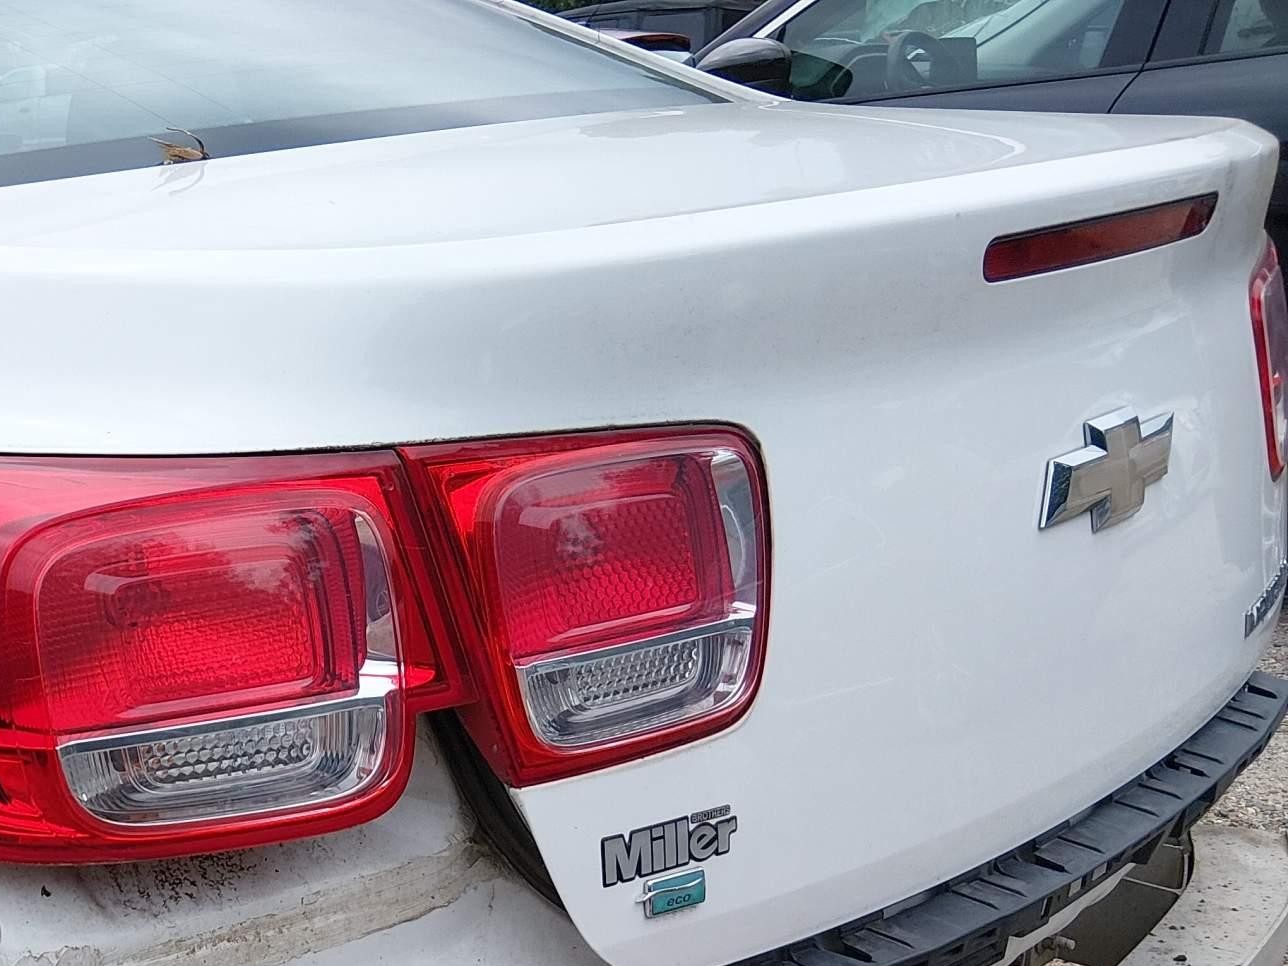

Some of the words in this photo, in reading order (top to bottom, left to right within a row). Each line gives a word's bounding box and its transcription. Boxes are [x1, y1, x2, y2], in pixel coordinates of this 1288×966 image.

[691, 805, 730, 823] BROTHERS
[601, 815, 737, 888] Miller
[667, 893, 691, 907] eco
